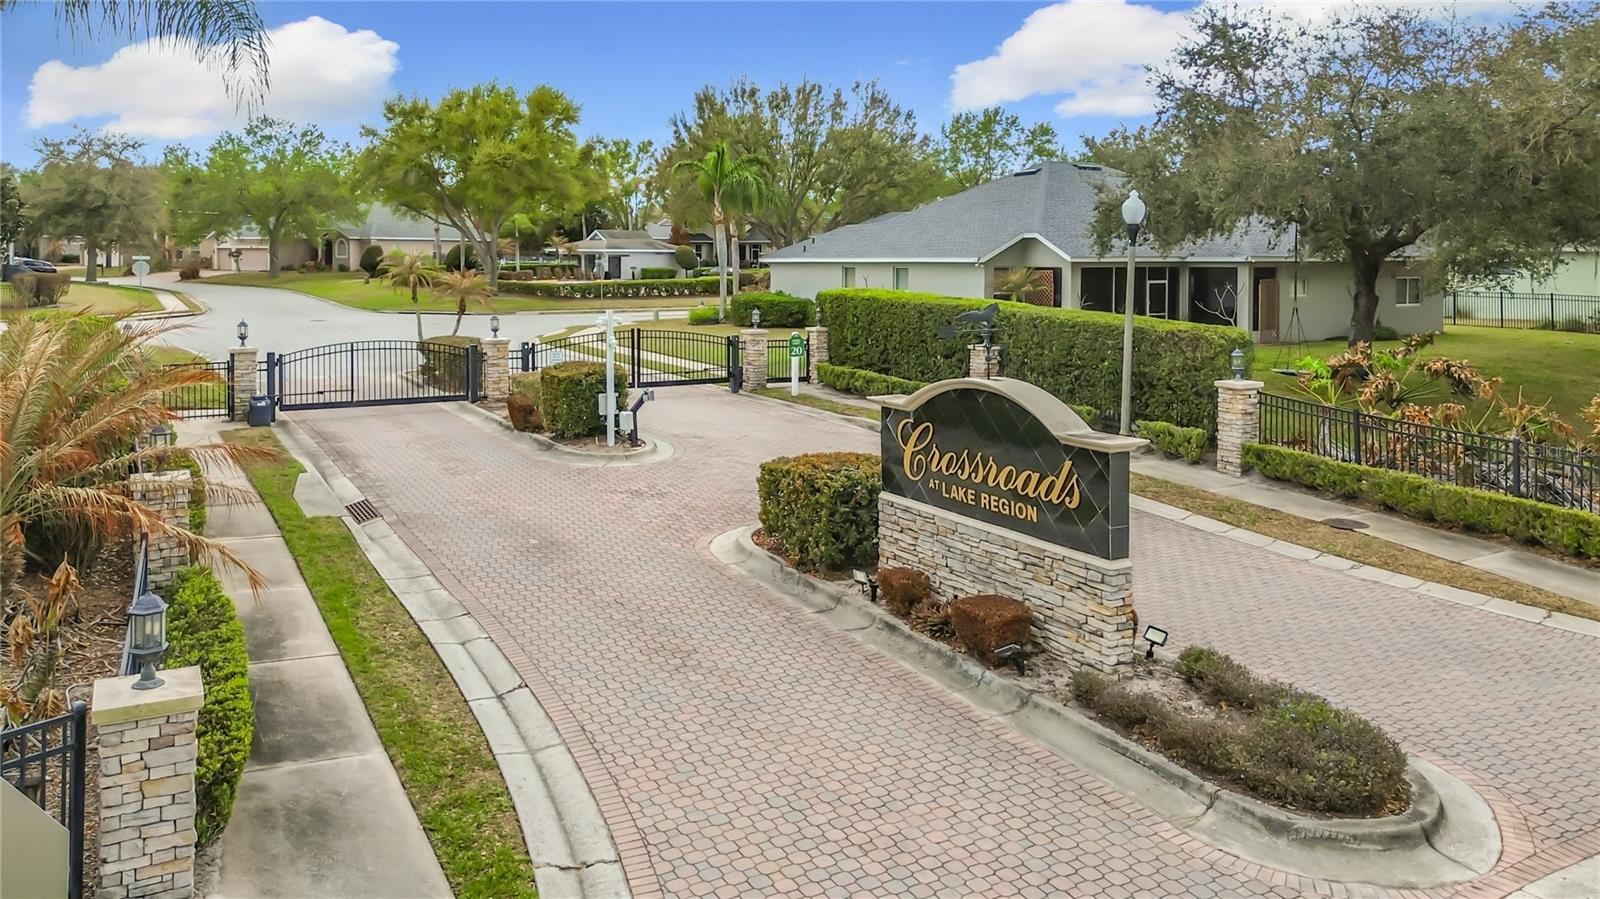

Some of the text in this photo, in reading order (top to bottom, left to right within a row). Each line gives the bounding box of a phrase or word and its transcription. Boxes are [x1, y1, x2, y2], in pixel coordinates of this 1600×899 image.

[790, 346, 802, 356] 20
[897, 418, 1081, 510] Crossroads
[928, 478, 1038, 523] AT LAKE REGION
